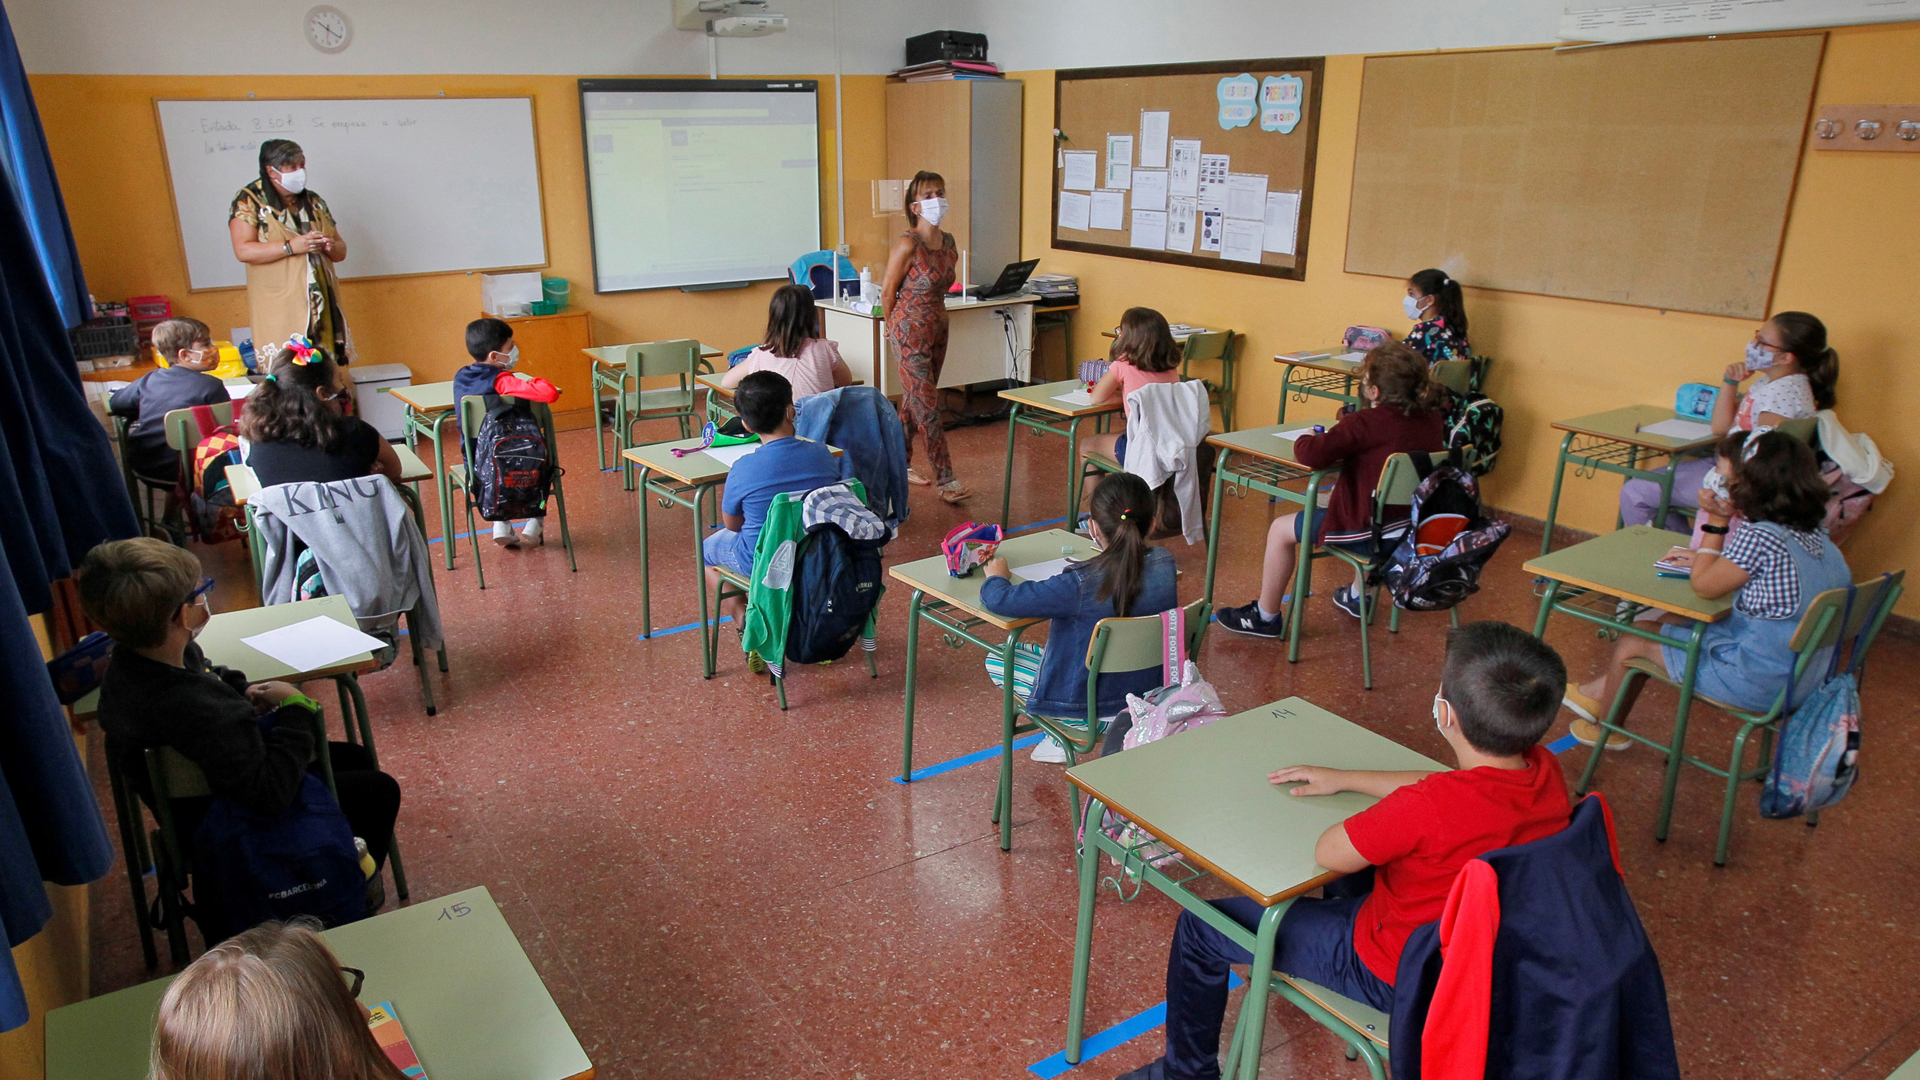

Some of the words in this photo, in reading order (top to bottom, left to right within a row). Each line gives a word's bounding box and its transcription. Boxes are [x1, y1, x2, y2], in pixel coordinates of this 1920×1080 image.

[279, 478, 380, 517] KING
[769, 545, 791, 573] A
[1240, 618, 1254, 629] N
[1169, 635, 1178, 662] FOOTY
[1271, 708, 1297, 719] 14
[438, 901, 472, 921] 15
